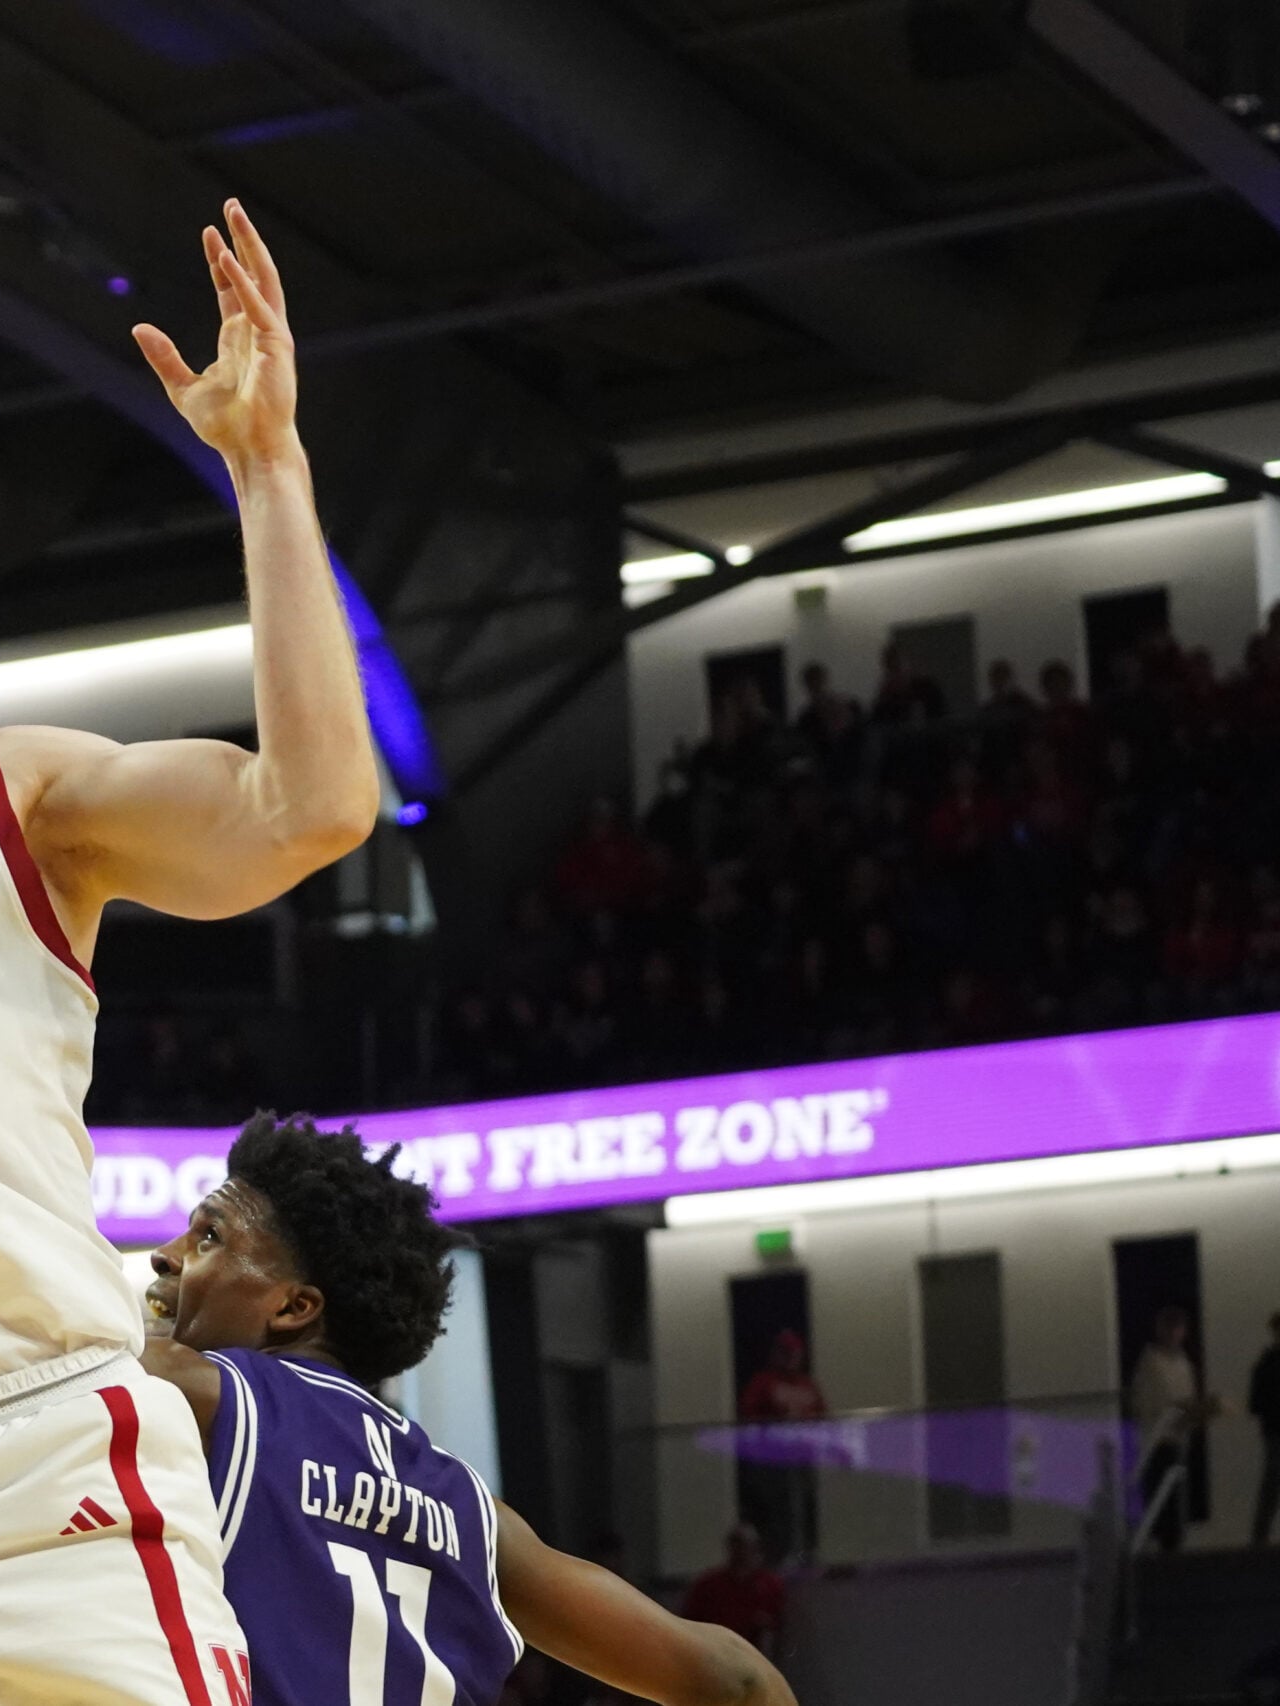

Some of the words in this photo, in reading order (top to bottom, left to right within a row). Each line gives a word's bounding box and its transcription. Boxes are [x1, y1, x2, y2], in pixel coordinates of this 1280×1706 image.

[488, 1111, 666, 1193] FREE
[676, 1088, 874, 1173] ZONE
[301, 1459, 460, 1561] CLAYTON
[327, 1541, 457, 1706] 11
